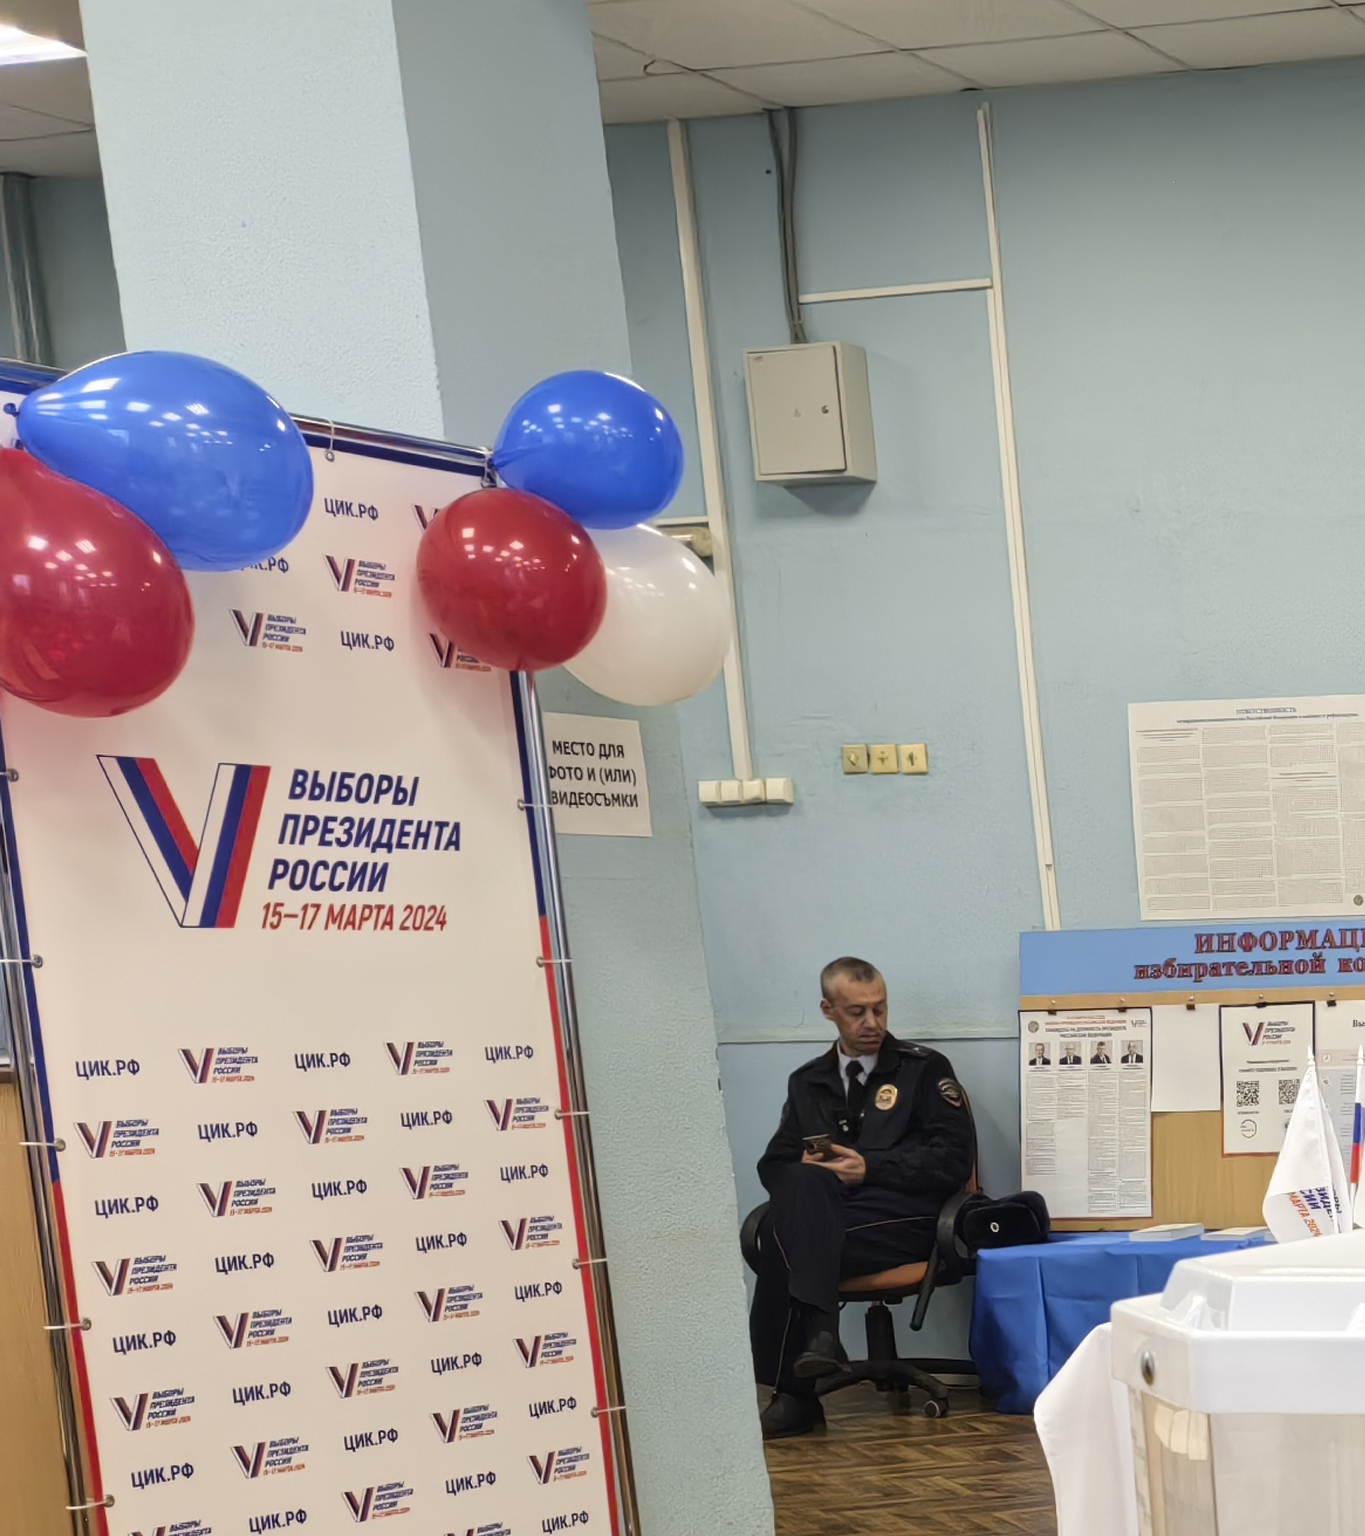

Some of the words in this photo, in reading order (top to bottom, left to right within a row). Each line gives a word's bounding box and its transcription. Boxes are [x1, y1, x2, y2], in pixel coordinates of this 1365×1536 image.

[324, 498, 378, 520] ЦИК.РФ
[341, 631, 394, 651] ЦИК.РФ
[552, 740, 595, 756] МЕСТО
[599, 743, 625, 760] ДЛЯ
[288, 769, 419, 806] ВЫБОРЫ
[587, 767, 596, 781] И
[599, 767, 637, 787] (ИЛИ)
[278, 814, 461, 853] ПРЕЗИДЕНТА
[268, 859, 389, 892] РОССИИ
[324, 903, 394, 931] МАРТА
[399, 904, 448, 931] 2024
[1134, 951, 1326, 982] избирательной
[295, 1052, 350, 1072] ЦИК.РФ
[485, 1045, 533, 1063] ЦИК.РФ
[76, 1059, 140, 1080] ЦИК.РФ
[401, 1110, 452, 1130] ЦИК.РФ
[198, 1122, 257, 1142] ЦИК.РФ
[500, 1164, 548, 1183] ЦИК.РФ
[312, 1179, 367, 1200] ЦИК.РФ
[95, 1195, 158, 1219] ЦИК.РФ
[416, 1232, 467, 1253] ЦИК.РФ
[215, 1252, 274, 1275] ЦИК.РФ
[515, 1281, 562, 1302] ЦИК.РФ
[328, 1304, 382, 1327] ЦИК.РФ
[113, 1330, 176, 1355] ЦИК.РФ
[431, 1352, 482, 1375] ЦИК.РФ
[233, 1381, 291, 1406] ЦИК.РФ
[529, 1397, 576, 1418] ЦИК.РФ
[344, 1428, 398, 1452] ЦИК.РФ
[131, 1463, 194, 1489] ЦИК.РФ
[446, 1471, 496, 1496] ЦИК.РФ
[249, 1509, 307, 1534] ЦИК.РФ
[542, 1511, 588, 1534] ЦИК.РФ
